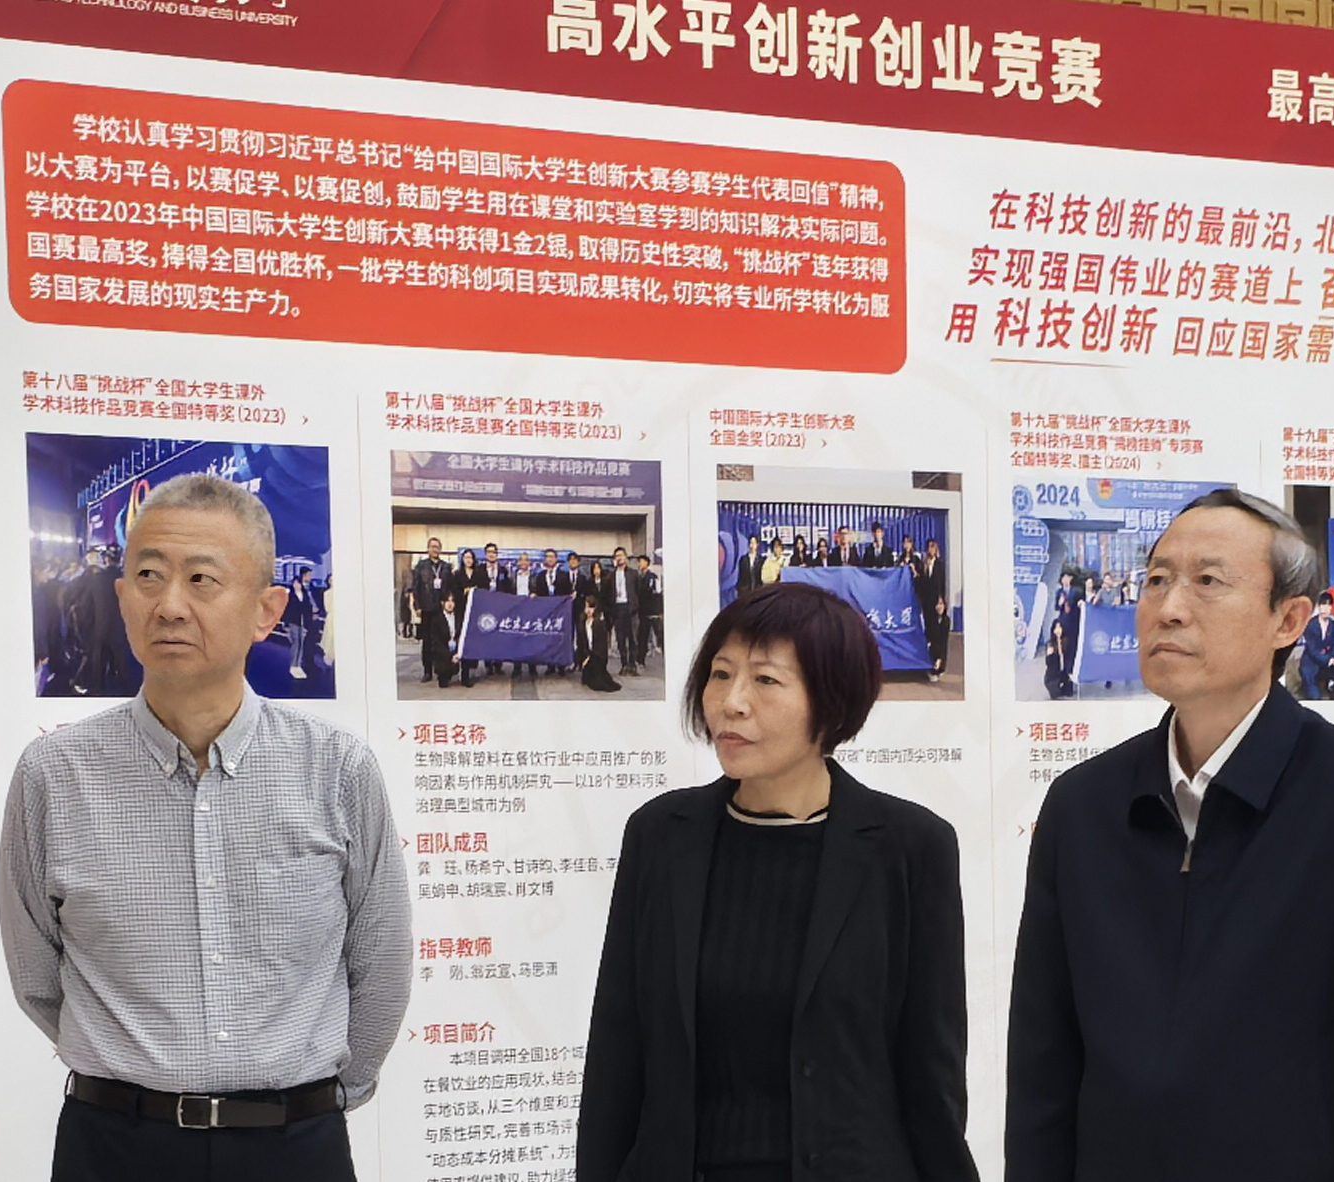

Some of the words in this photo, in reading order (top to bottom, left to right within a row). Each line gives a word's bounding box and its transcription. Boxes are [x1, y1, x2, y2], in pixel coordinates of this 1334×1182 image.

[547, 0, 1103, 108] 高水平创新创业竞赛
[29, 272, 302, 319] 务国家发展的现实生产力。
[945, 302, 977, 345] 用
[993, 297, 1158, 355] 科技创新
[1036, 483, 1080, 506] 2024
[413, 724, 487, 745] 项目名称
[1028, 722, 1090, 742] 项目名称
[416, 833, 488, 854] 团队成员
[420, 937, 492, 960] 指导教师
[424, 1021, 496, 1044] 项目简介
